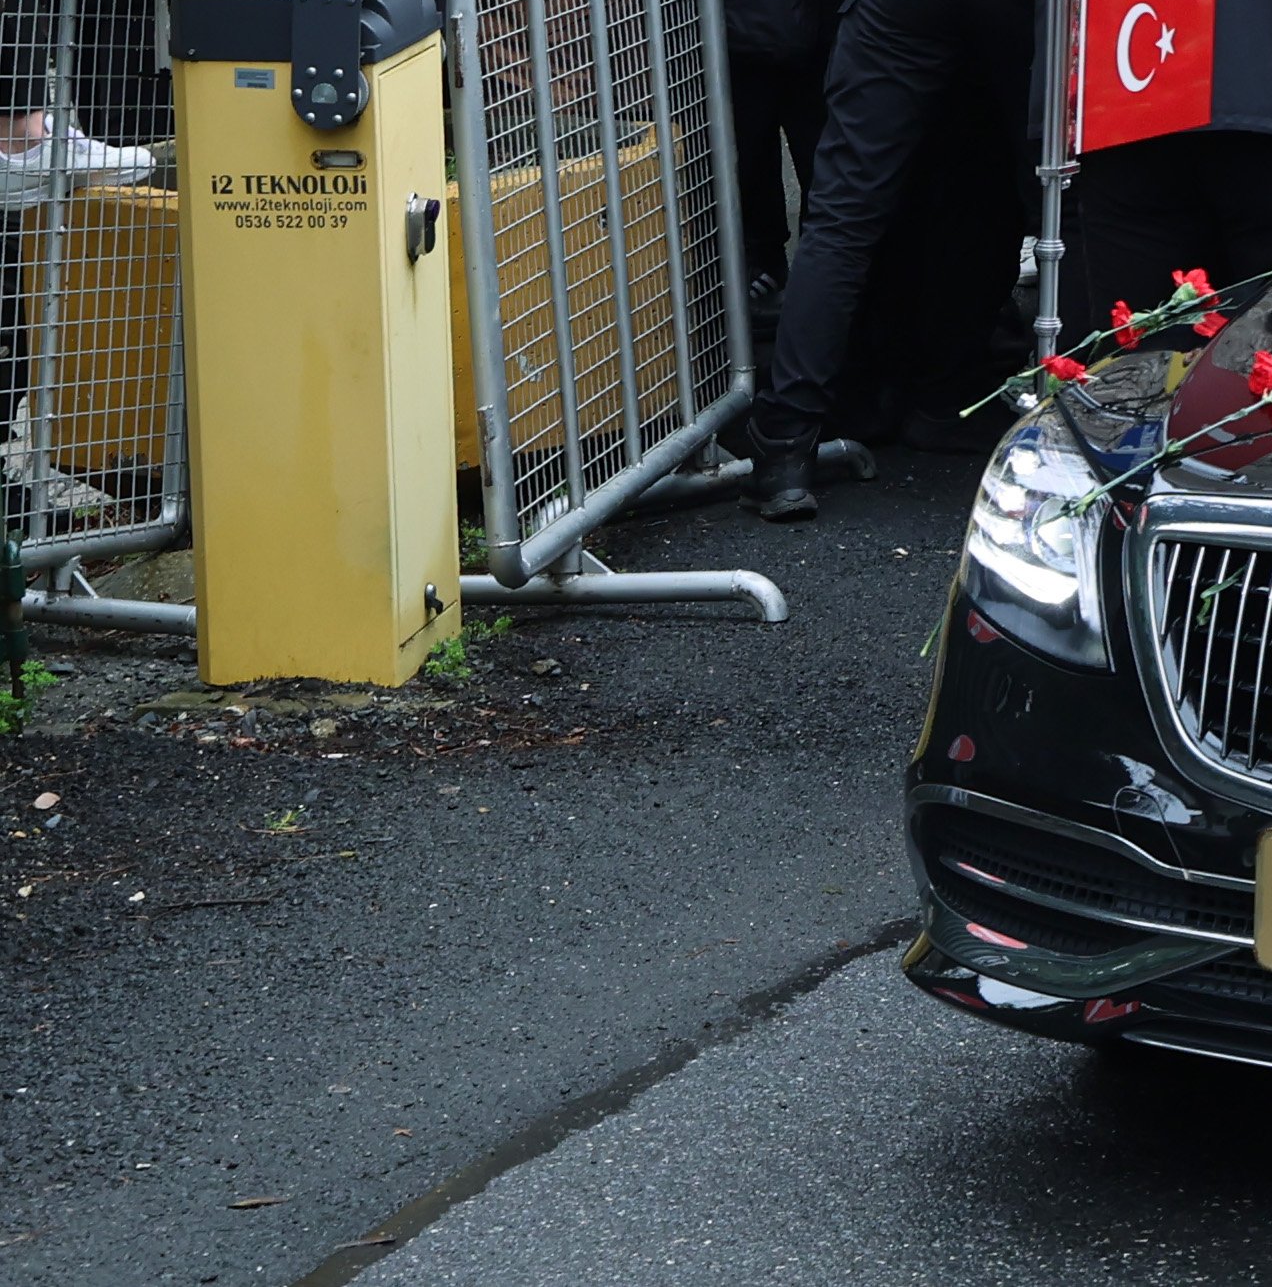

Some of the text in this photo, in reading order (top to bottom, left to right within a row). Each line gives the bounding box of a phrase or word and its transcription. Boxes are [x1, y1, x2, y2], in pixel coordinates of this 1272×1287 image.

[214, 199, 368, 214] www.i2teknoloji.com
[235, 215, 348, 229] 0536 522 00 39
